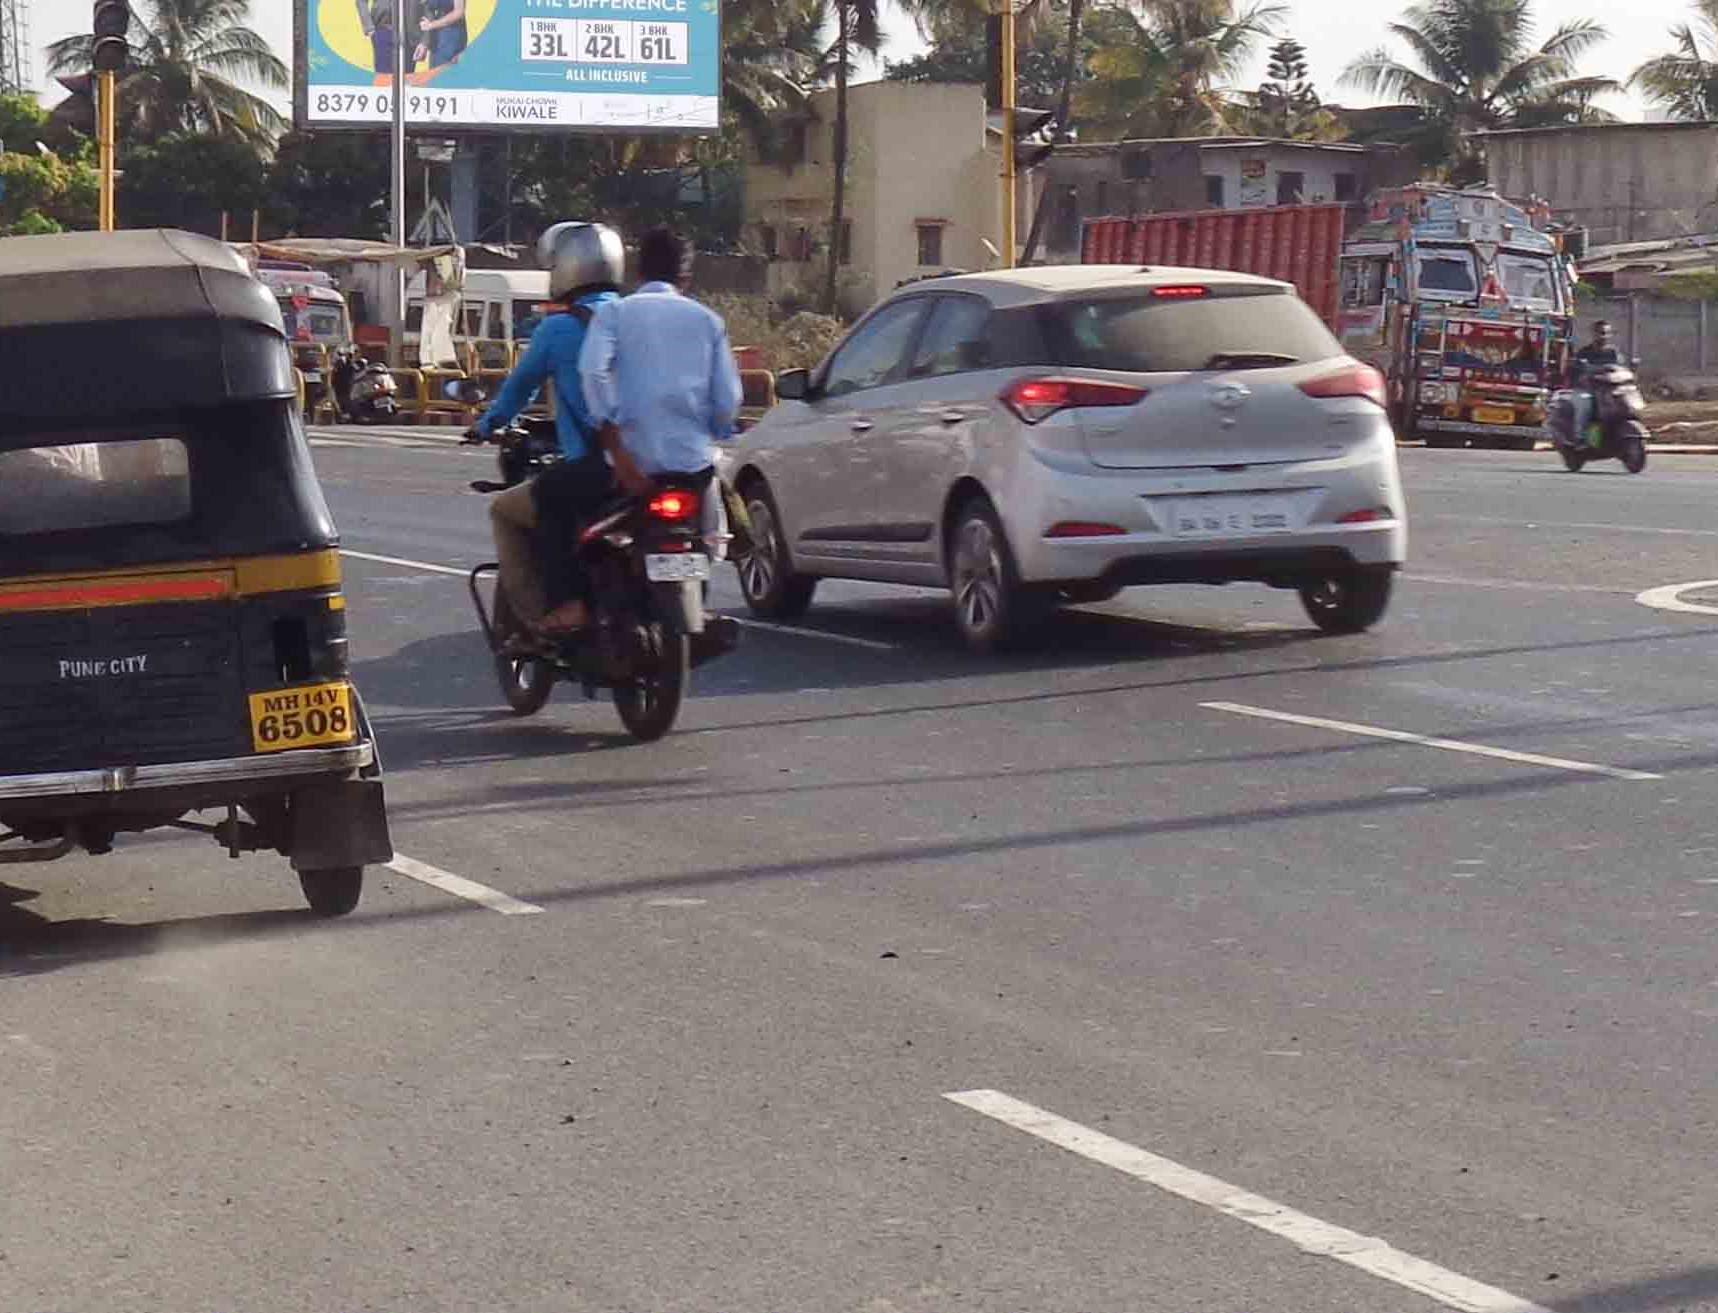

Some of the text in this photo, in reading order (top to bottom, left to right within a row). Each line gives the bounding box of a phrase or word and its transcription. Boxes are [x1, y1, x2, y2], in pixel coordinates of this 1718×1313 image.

[530, 21, 557, 33] 1 BHK
[585, 24, 614, 35] 2 BHK
[648, 26, 668, 36] BHK
[529, 34, 568, 57] 33L
[585, 36, 626, 59] 42L
[640, 38, 676, 60] 61L
[566, 69, 649, 84] ALL INCLUSIVE
[316, 93, 369, 113] 8379
[409, 96, 458, 116] 9191
[496, 106, 557, 119] KIWALE
[59, 654, 148, 679] PUNE CITY
[264, 694, 299, 713] MH
[258, 705, 347, 743] 6508
